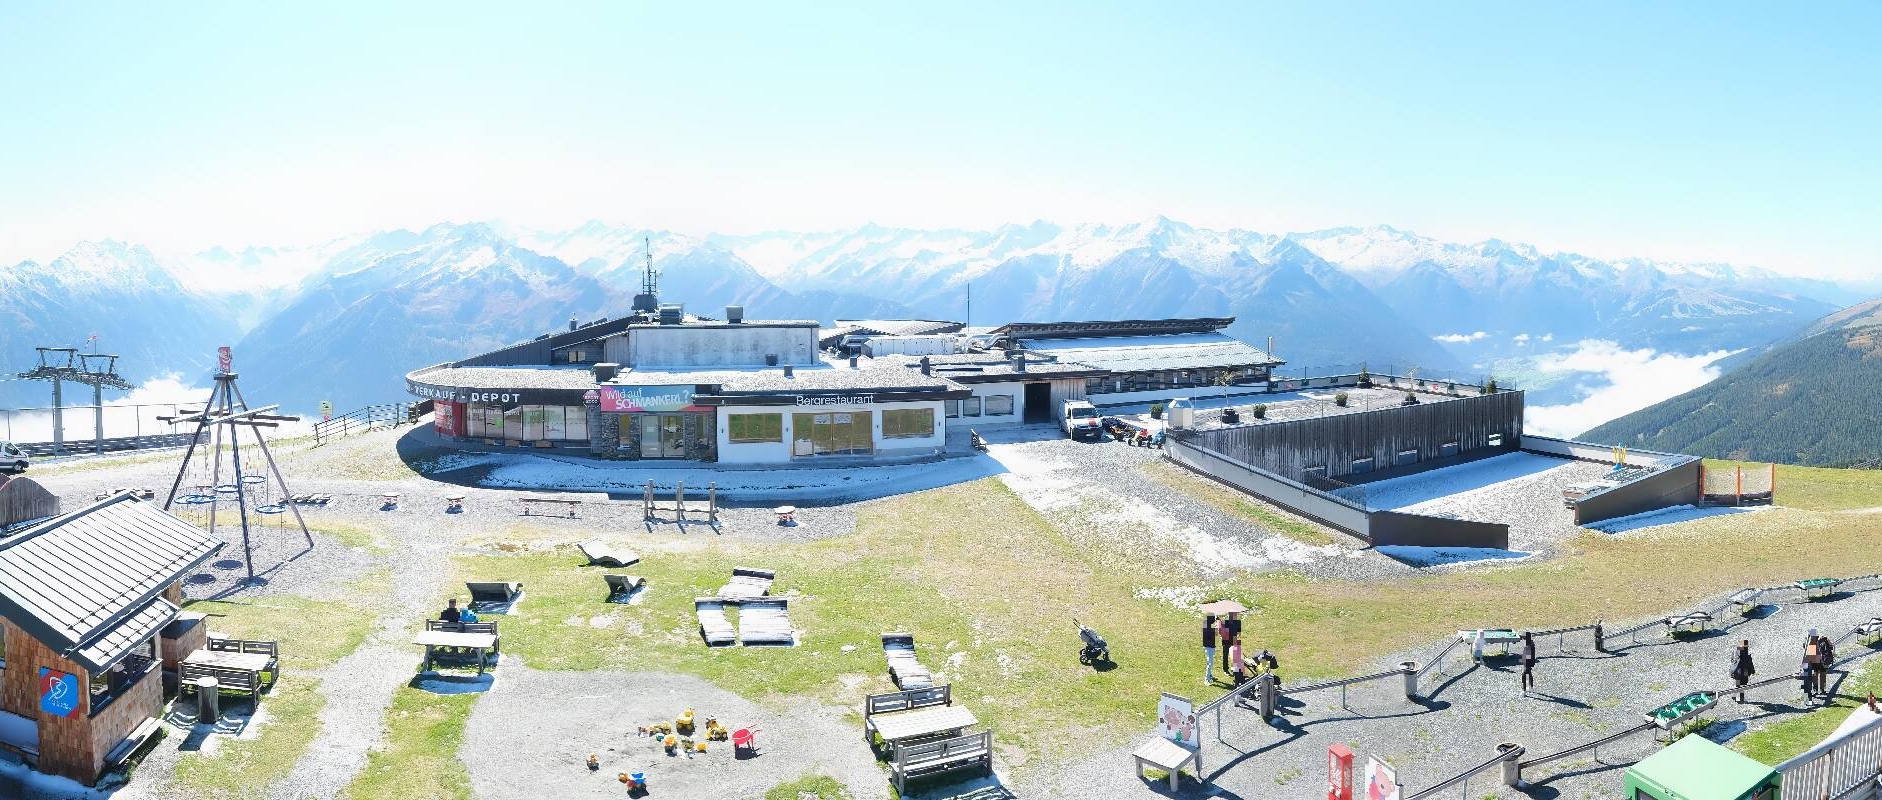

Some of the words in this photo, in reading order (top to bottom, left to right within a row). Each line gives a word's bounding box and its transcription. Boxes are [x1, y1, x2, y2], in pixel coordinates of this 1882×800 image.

[414, 385, 456, 400] VERKAUF
[471, 392, 521, 403] DEPOT
[605, 388, 626, 400] Wild
[627, 387, 643, 398] auf
[796, 394, 874, 406] Bergrestaurant
